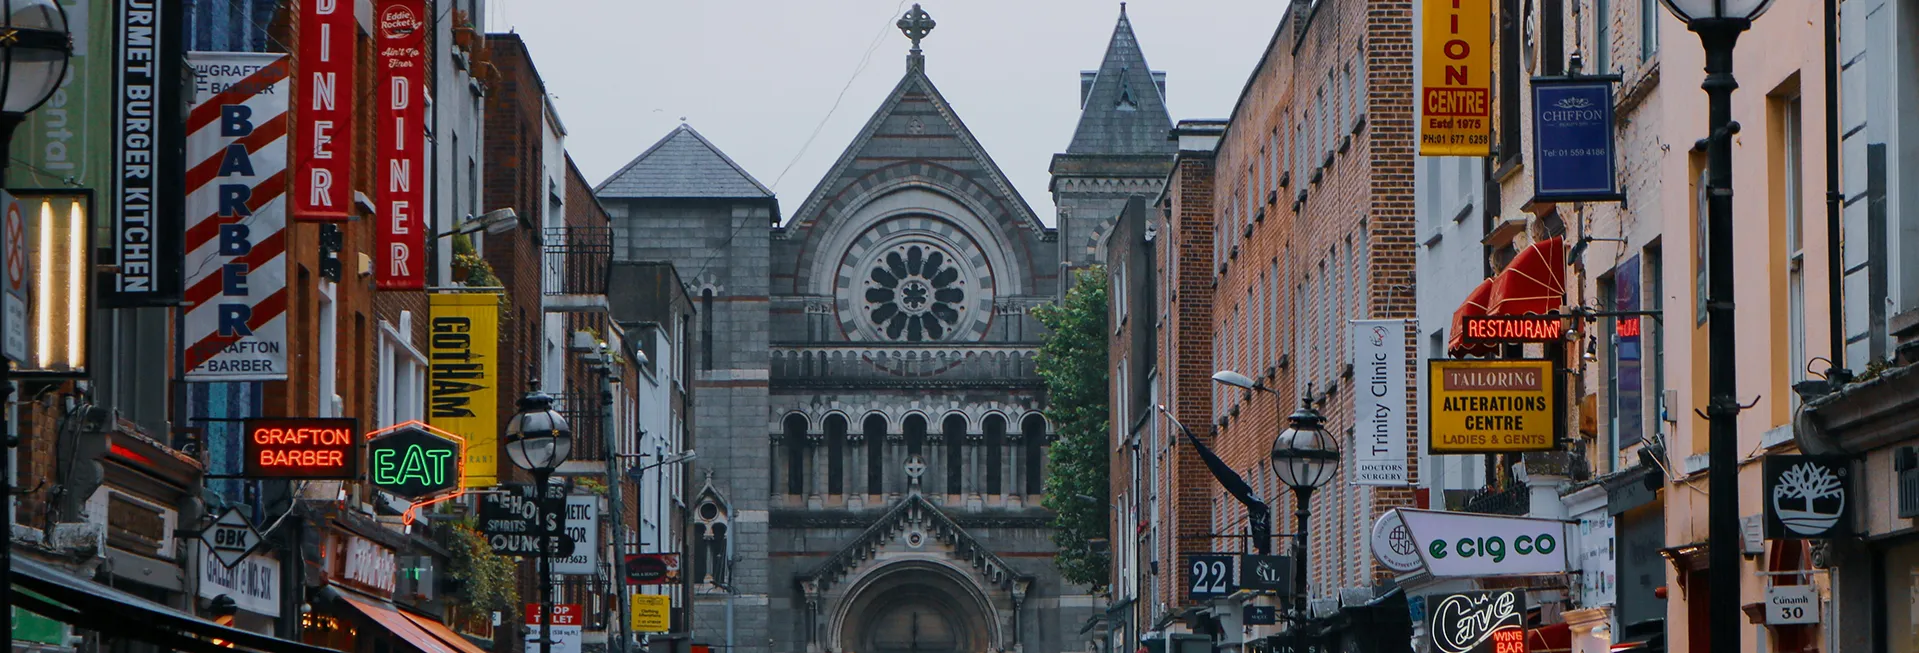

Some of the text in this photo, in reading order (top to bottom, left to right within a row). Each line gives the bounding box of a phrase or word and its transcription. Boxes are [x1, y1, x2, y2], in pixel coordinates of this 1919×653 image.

[386, 11, 411, 21] Eddie
[209, 64, 283, 77] GRAFTON
[196, 64, 208, 94] THE
[210, 82, 275, 95] BARBER
[1428, 90, 1484, 114] CENTRE
[1429, 118, 1482, 129] Estd 1975
[1542, 110, 1603, 122] CHIFFON
[125, 84, 152, 179] BURGER
[1422, 134, 1488, 145] PH:01 677 6258
[1543, 149, 1557, 157] Tel:
[1558, 149, 1568, 157] 01
[389, 76, 410, 276] DINER
[217, 104, 255, 337] BARBER
[124, 187, 150, 292] KITCHEN
[1468, 319, 1561, 339] RESTAURANT
[207, 341, 279, 354] GRAFTON
[208, 359, 273, 372] BARBER
[432, 317, 487, 418] GOTHAM
[1451, 372, 1536, 388] TAILORING
[1371, 353, 1391, 456] Trinity Clinic
[1443, 396, 1546, 411] ALTERATIONS
[1465, 415, 1523, 430] CENTRE
[254, 428, 350, 446] GRAFTON
[1443, 434, 1546, 445] LADIES & GENTS
[259, 450, 344, 467] BARBER
[374, 444, 452, 487] EAT
[522, 485, 564, 498] WIES
[487, 519, 527, 531] SPIRITS
[214, 528, 247, 548] GBK
[484, 533, 559, 553] OUNE
[1428, 539, 1448, 559] e
[1456, 536, 1506, 563] cig
[1514, 533, 1556, 555] co
[260, 566, 272, 601] SIX
[1192, 560, 1226, 593] 22
[1474, 594, 1488, 604] LA
[553, 615, 574, 623] LET
[1781, 606, 1804, 620] 30
[1432, 591, 1516, 653] Cave
[1494, 631, 1523, 641] WINE
[1496, 642, 1524, 653] BAR
